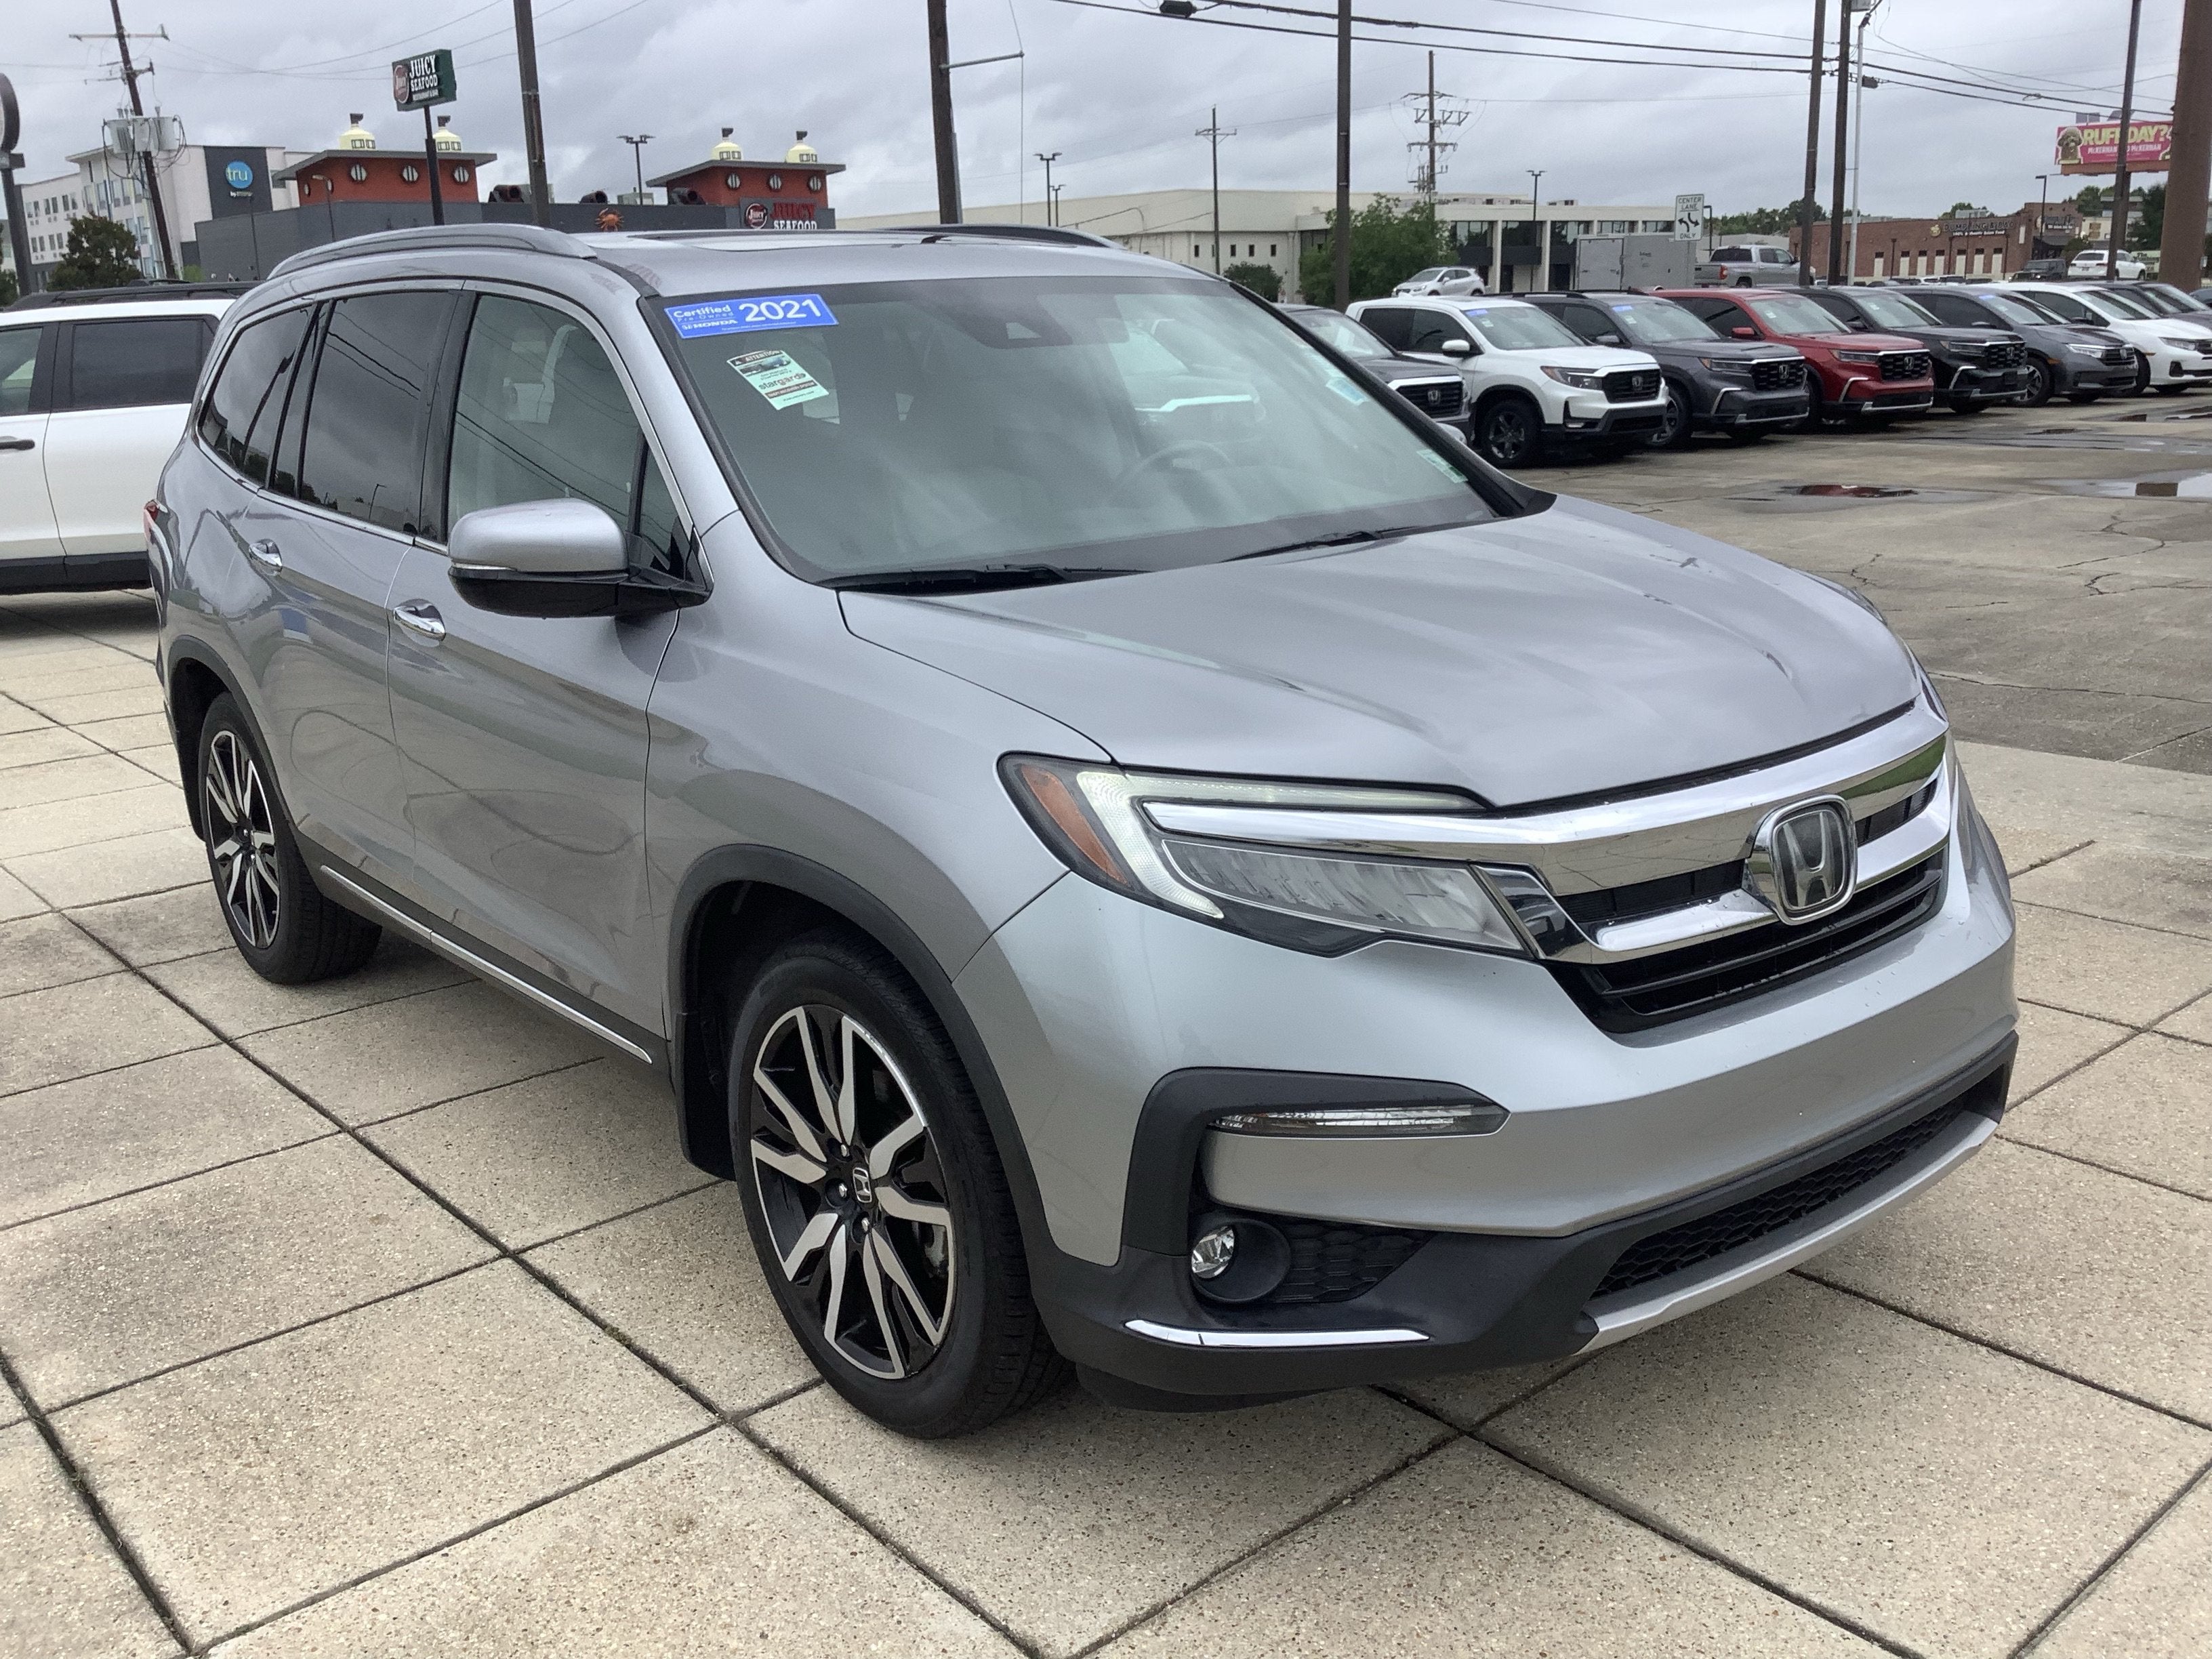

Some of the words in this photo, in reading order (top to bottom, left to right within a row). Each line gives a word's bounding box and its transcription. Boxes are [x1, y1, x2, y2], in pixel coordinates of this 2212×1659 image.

[409, 54, 436, 79] JUICY
[410, 74, 438, 91] SEAFOOD
[2128, 124, 2169, 144] DAY?
[226, 167, 248, 181] tru
[770, 203, 815, 220] JUICY
[773, 220, 817, 230] SEAFOOD
[673, 304, 731, 318] Certified
[739, 299, 821, 323] 2021
[693, 319, 738, 329] HONDA
